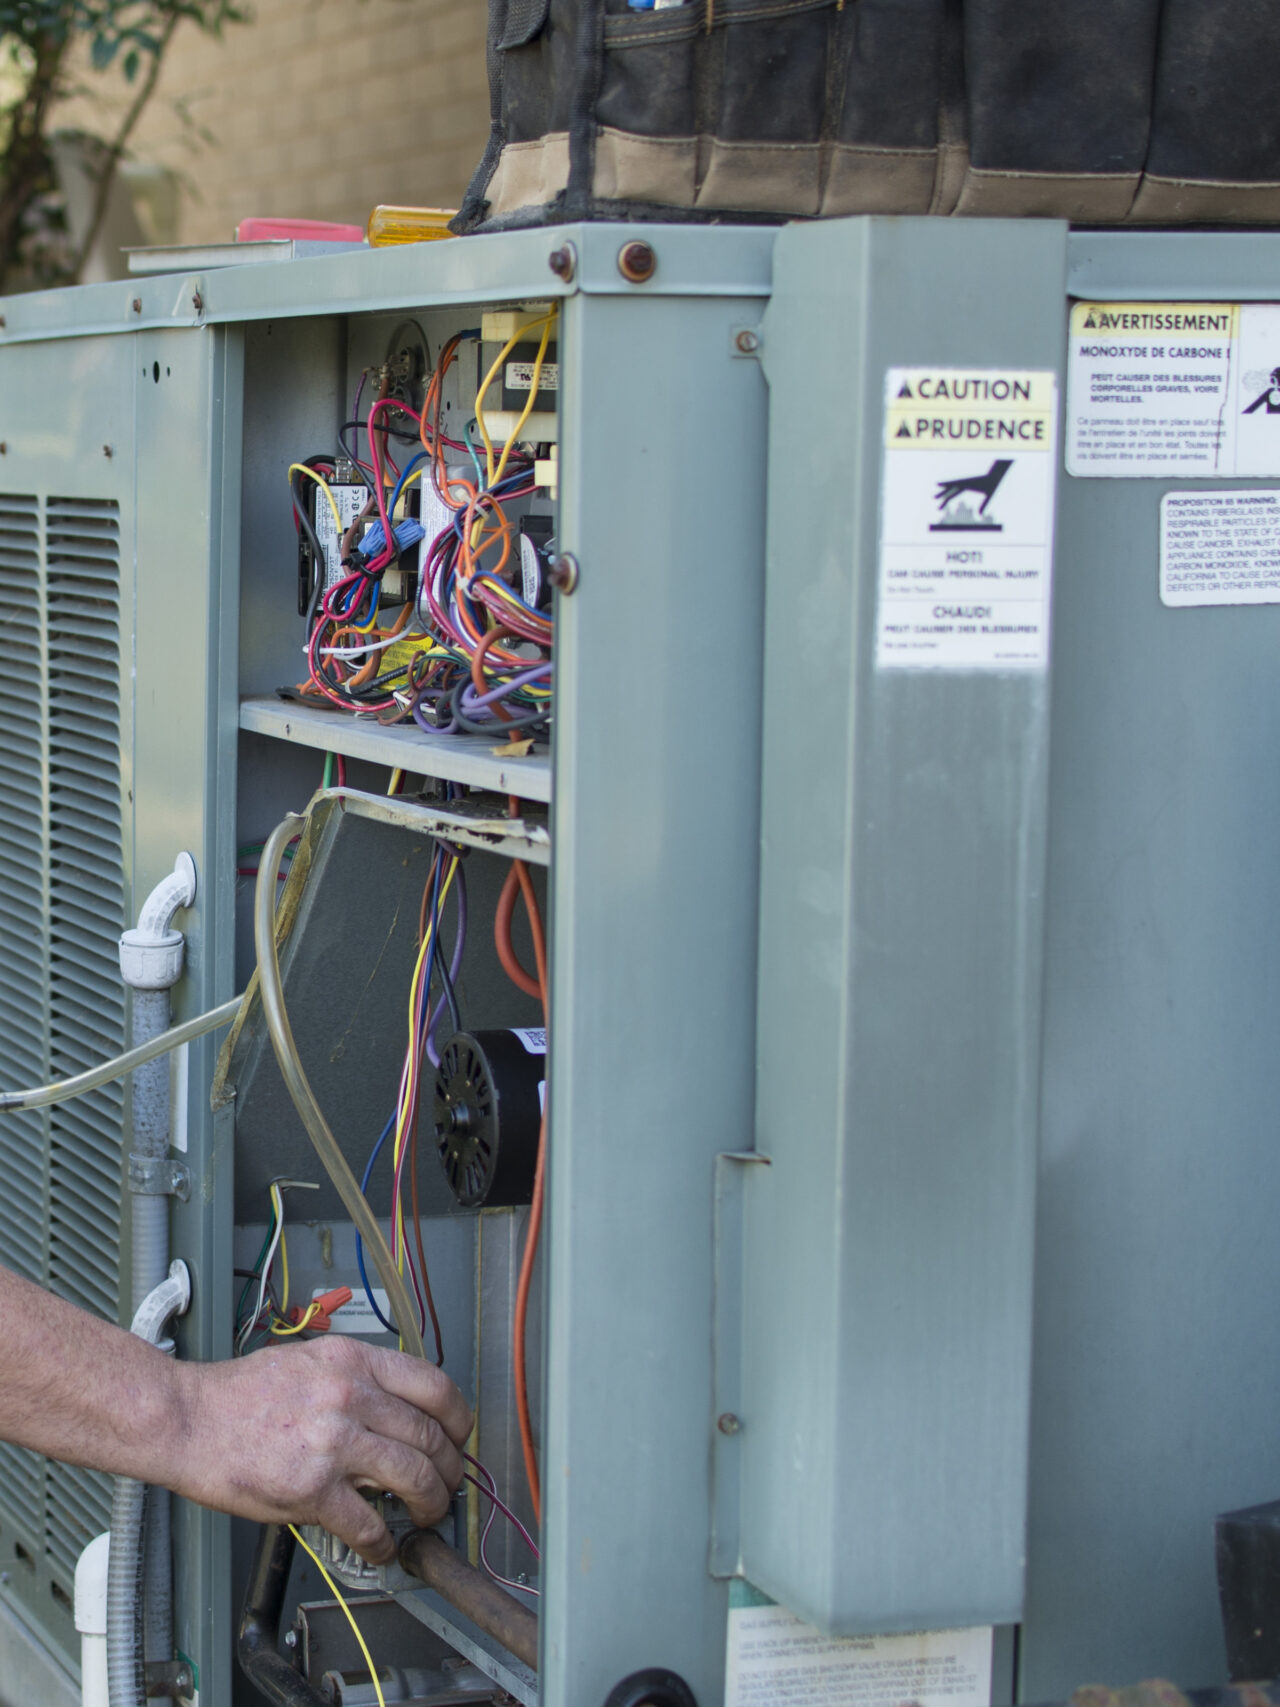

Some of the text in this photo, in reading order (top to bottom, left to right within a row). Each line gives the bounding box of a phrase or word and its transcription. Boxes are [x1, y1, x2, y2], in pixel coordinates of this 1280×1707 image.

[1100, 314, 1228, 330] AVERTISSEMENT
[1080, 346, 1147, 358] MONOXYDE
[1151, 347, 1165, 358] DE
[1169, 347, 1222, 358] CARBONE
[1116, 374, 1150, 382] CAUSER
[1153, 374, 1170, 382] DES
[1172, 374, 1222, 382] BLESSURES
[918, 378, 1030, 400] CAUTION
[1090, 384, 1152, 393] CORPORELLES
[1194, 385, 1218, 393] VOIRE
[916, 419, 1044, 440] PRUDENCE
[1168, 498, 1222, 506] PROPOSITION
[1168, 508, 1209, 518] CONTAINS
[1212, 508, 1264, 516] FIBERGLASS
[1168, 519, 1219, 528] RESPIRABLE
[1222, 518, 1266, 526] PARTICLES
[1168, 530, 1198, 538] KNOWN
[1202, 529, 1212, 538] TO
[1215, 529, 1231, 538] THE
[1234, 528, 1258, 537] STATE
[1260, 528, 1272, 536] OF
[1168, 541, 1195, 550] CAUSE
[1238, 538, 1276, 547] EXHAUST
[1168, 551, 1213, 560] APPLIANCE
[1216, 550, 1258, 558] CONTAINS
[1167, 562, 1202, 570] CARBON
[1167, 572, 1217, 581] CALIFORNIA
[1220, 571, 1230, 580] TO
[1232, 570, 1260, 579] CAUSE
[1168, 583, 1206, 592] DEFECTS
[1208, 582, 1220, 591] OR
[1222, 582, 1252, 590] OTHER
